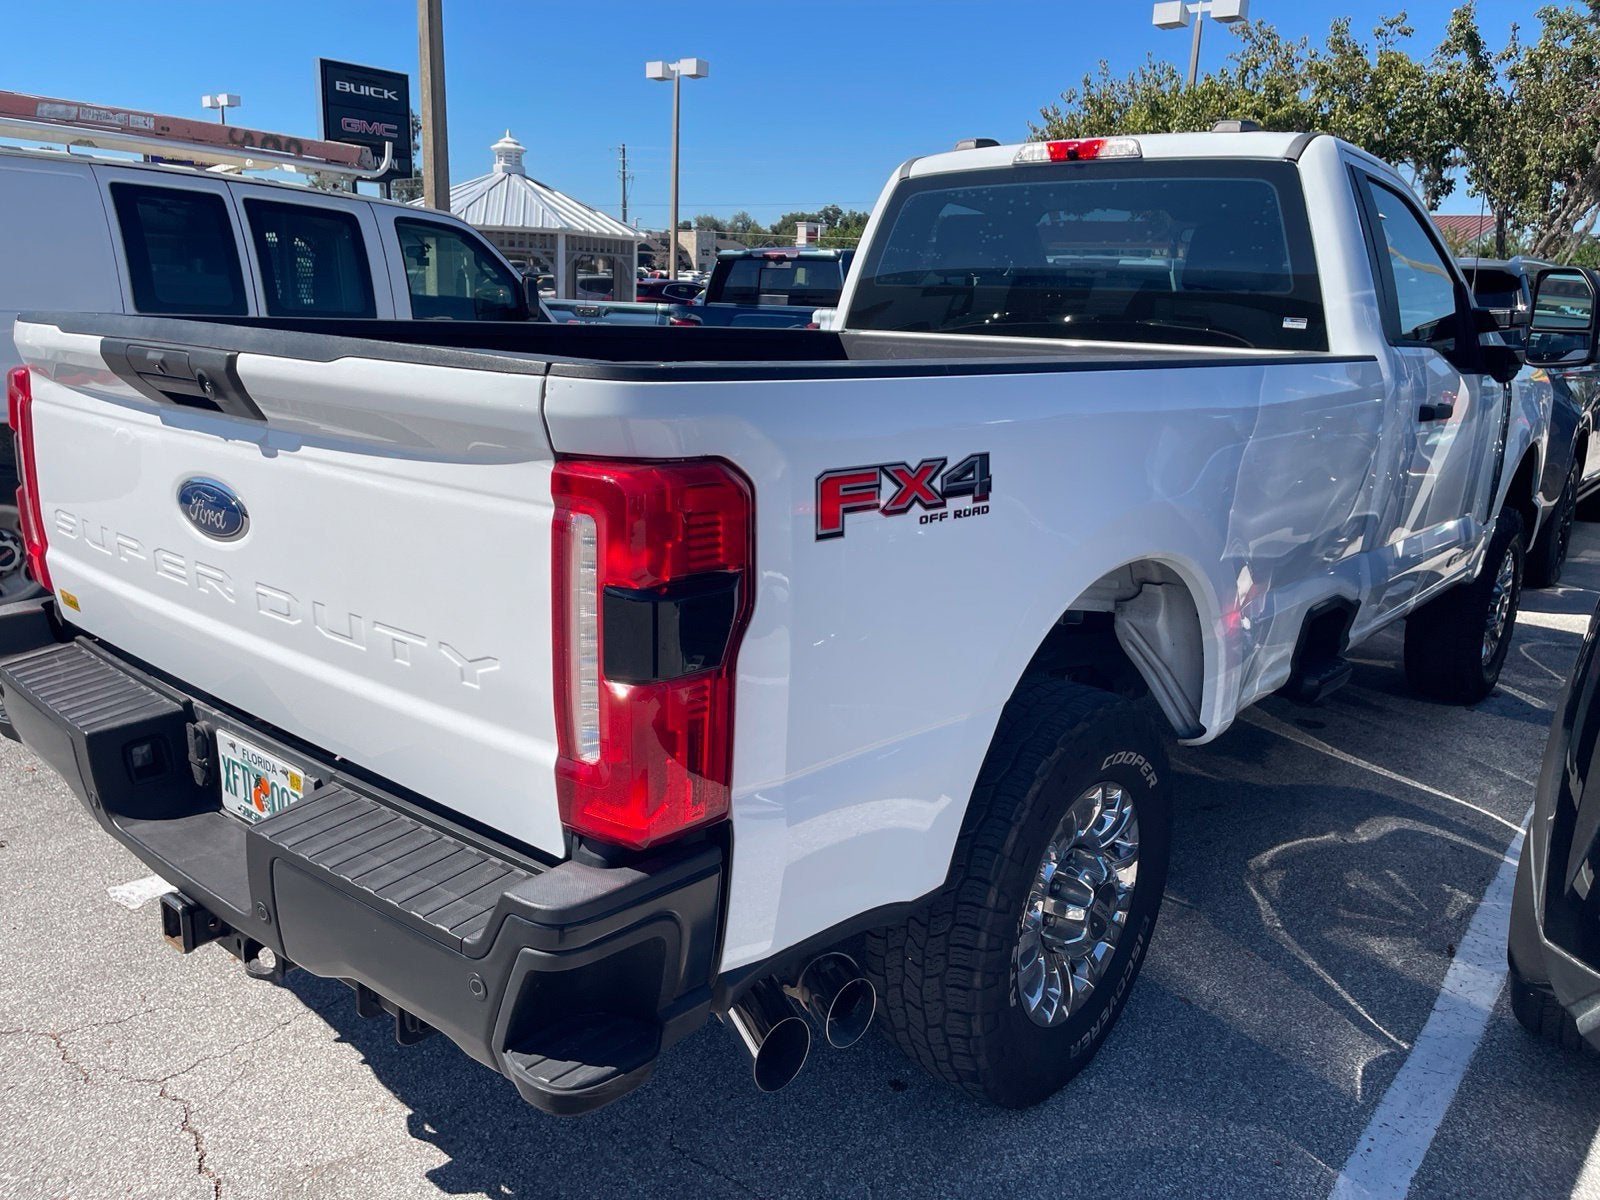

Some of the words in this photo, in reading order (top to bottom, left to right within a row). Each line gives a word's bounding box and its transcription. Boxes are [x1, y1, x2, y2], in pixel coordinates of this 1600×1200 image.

[335, 80, 399, 101] BUICK
[341, 117, 398, 138] GMC
[815, 452, 992, 542] FX4
[919, 511, 948, 525] OFF
[953, 505, 990, 520] ROAD
[55, 509, 236, 604] SUPER
[255, 581, 500, 690] DUTY
[241, 748, 277, 776] FLORIDA
[1101, 751, 1158, 789] COOPER
[1069, 912, 1151, 1060] DISCOVERER
